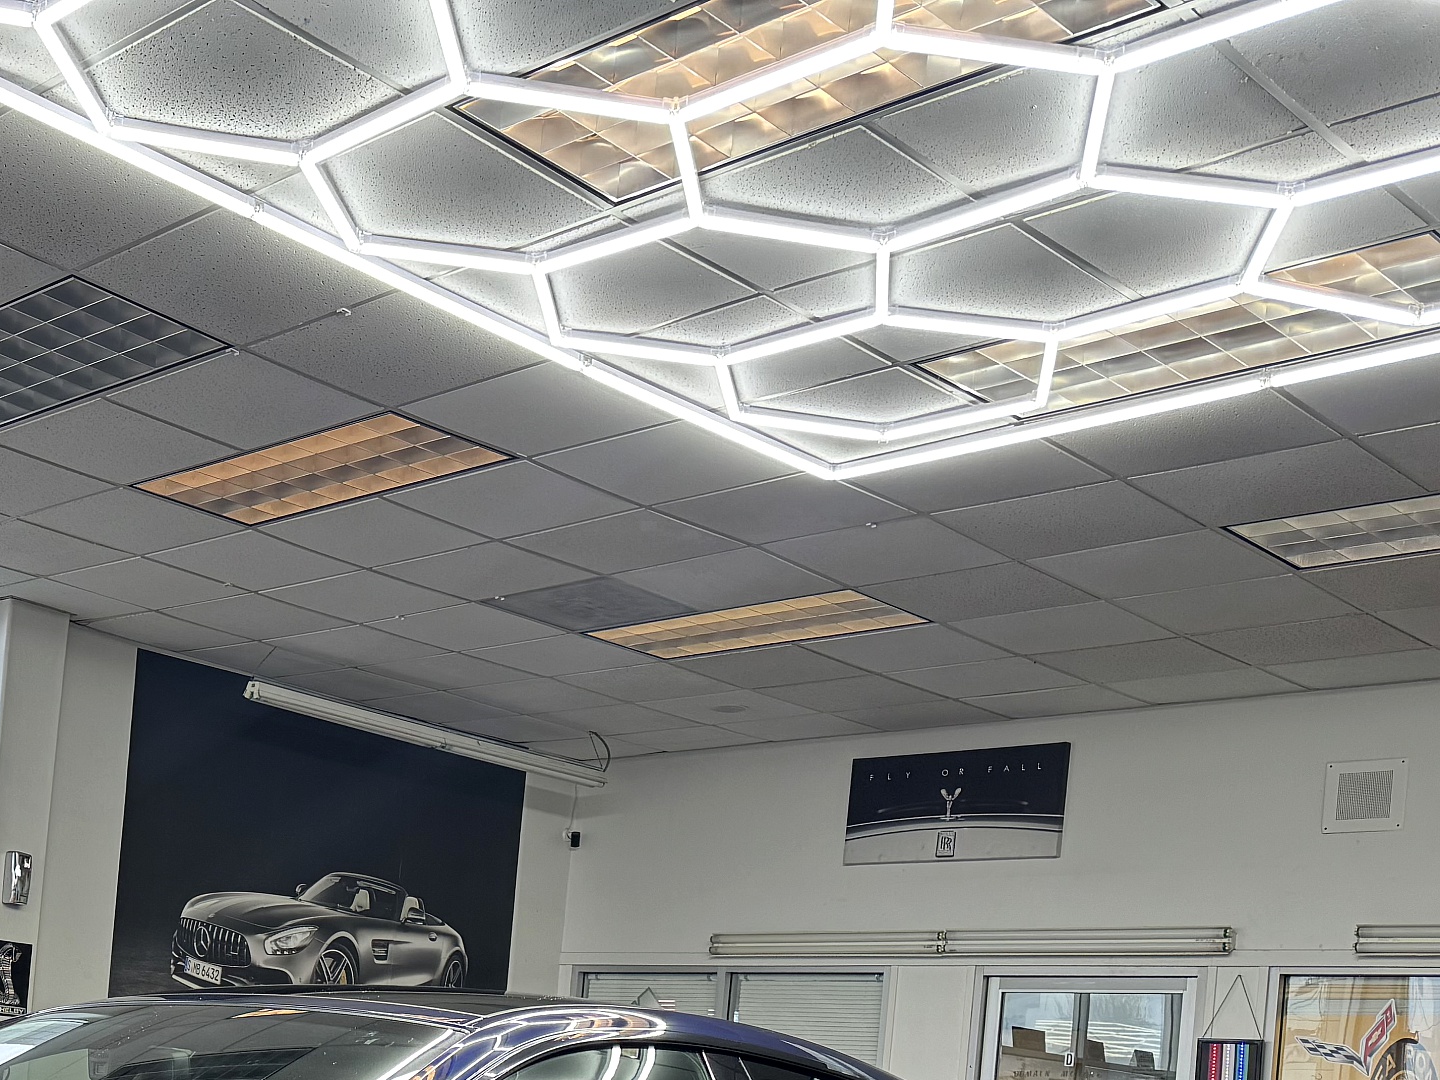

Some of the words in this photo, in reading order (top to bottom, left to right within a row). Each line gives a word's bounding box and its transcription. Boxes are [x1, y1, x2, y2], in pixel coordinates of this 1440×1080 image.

[869, 771, 911, 782] FLY
[941, 768, 964, 777] OR
[987, 762, 1042, 774] FALL
